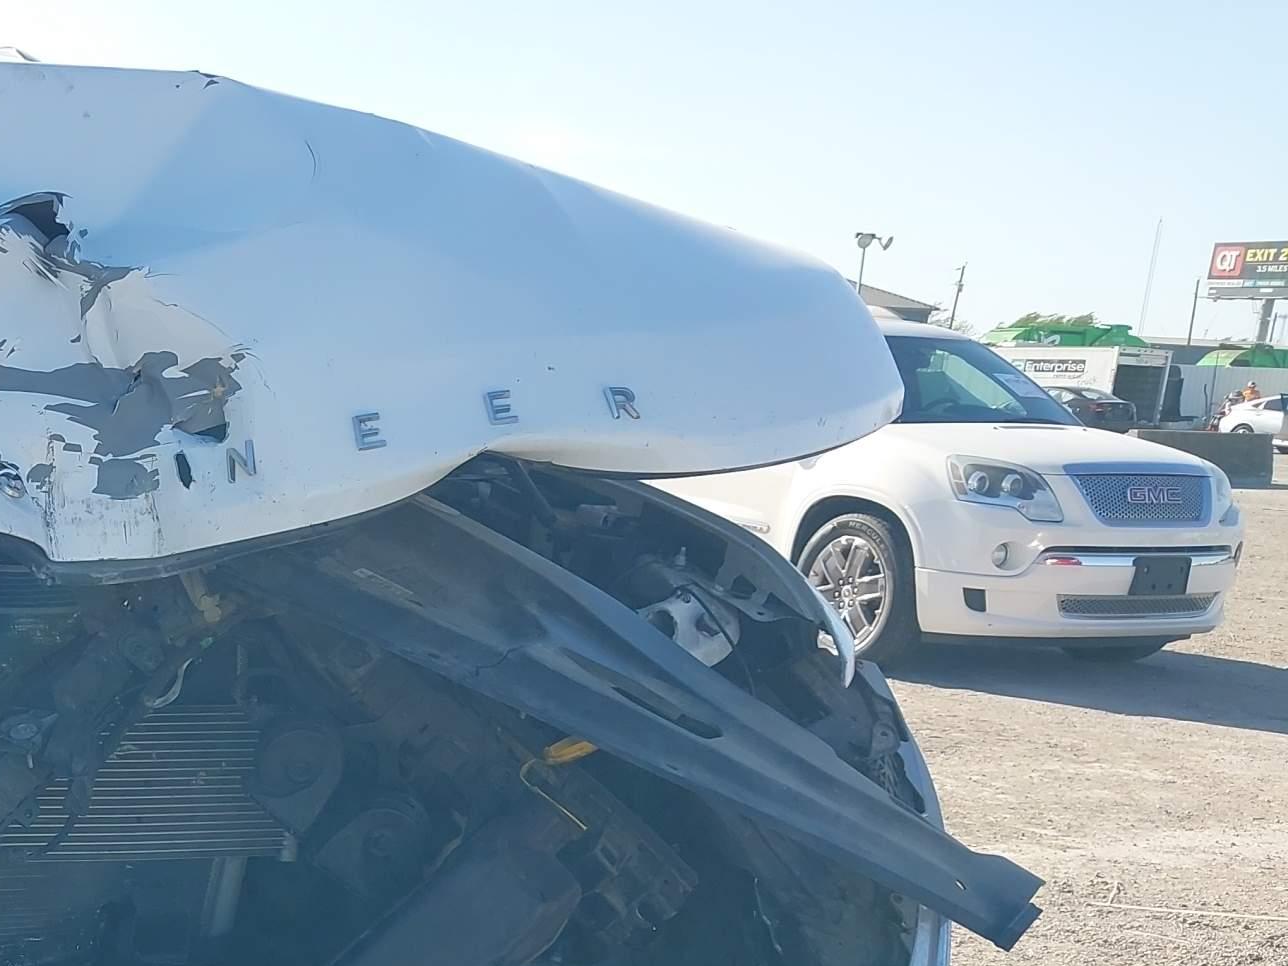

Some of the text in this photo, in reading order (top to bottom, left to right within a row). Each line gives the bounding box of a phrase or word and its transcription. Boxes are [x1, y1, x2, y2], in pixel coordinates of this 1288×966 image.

[1216, 250, 1240, 272] QT
[1246, 248, 1277, 261] EXIT
[1025, 360, 1085, 374] Enterprise
[1128, 486, 1181, 503] GMC
